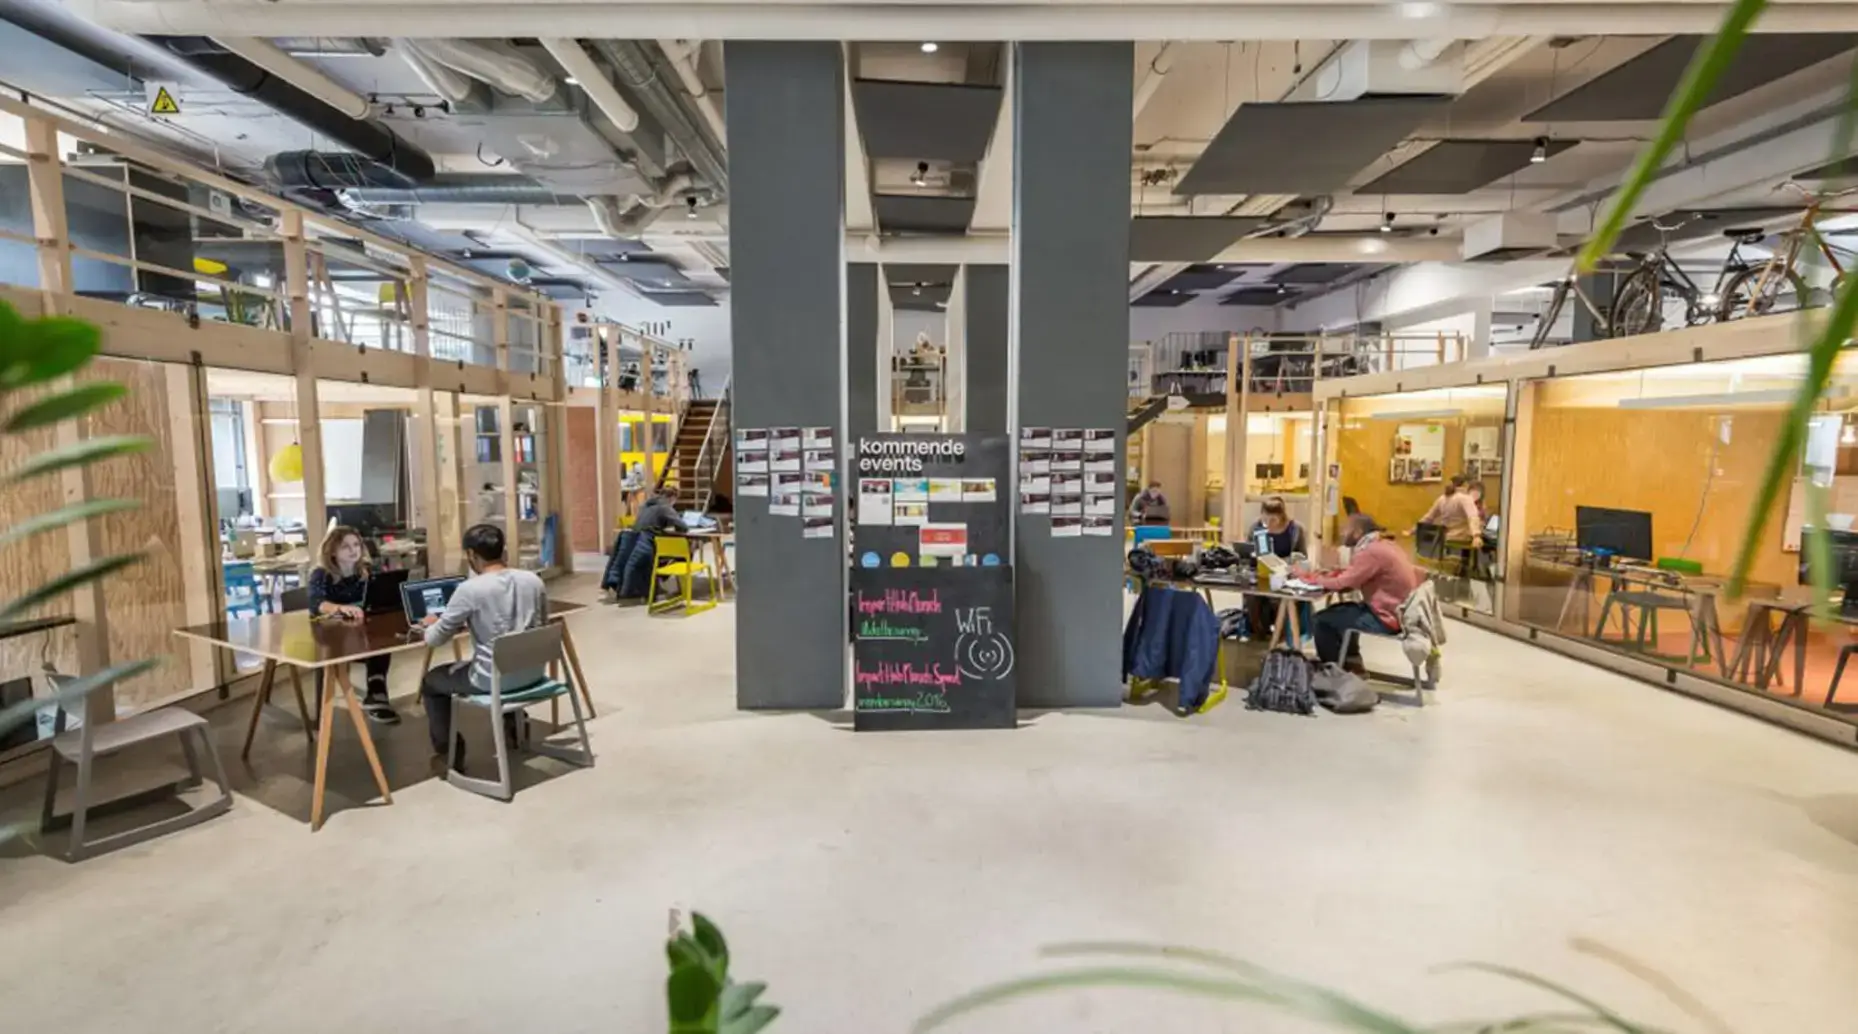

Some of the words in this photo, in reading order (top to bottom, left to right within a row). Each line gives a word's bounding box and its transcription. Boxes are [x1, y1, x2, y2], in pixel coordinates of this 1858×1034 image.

[860, 438, 965, 455] kommende
[860, 457, 923, 471] events
[955, 607, 992, 635] WiFi
